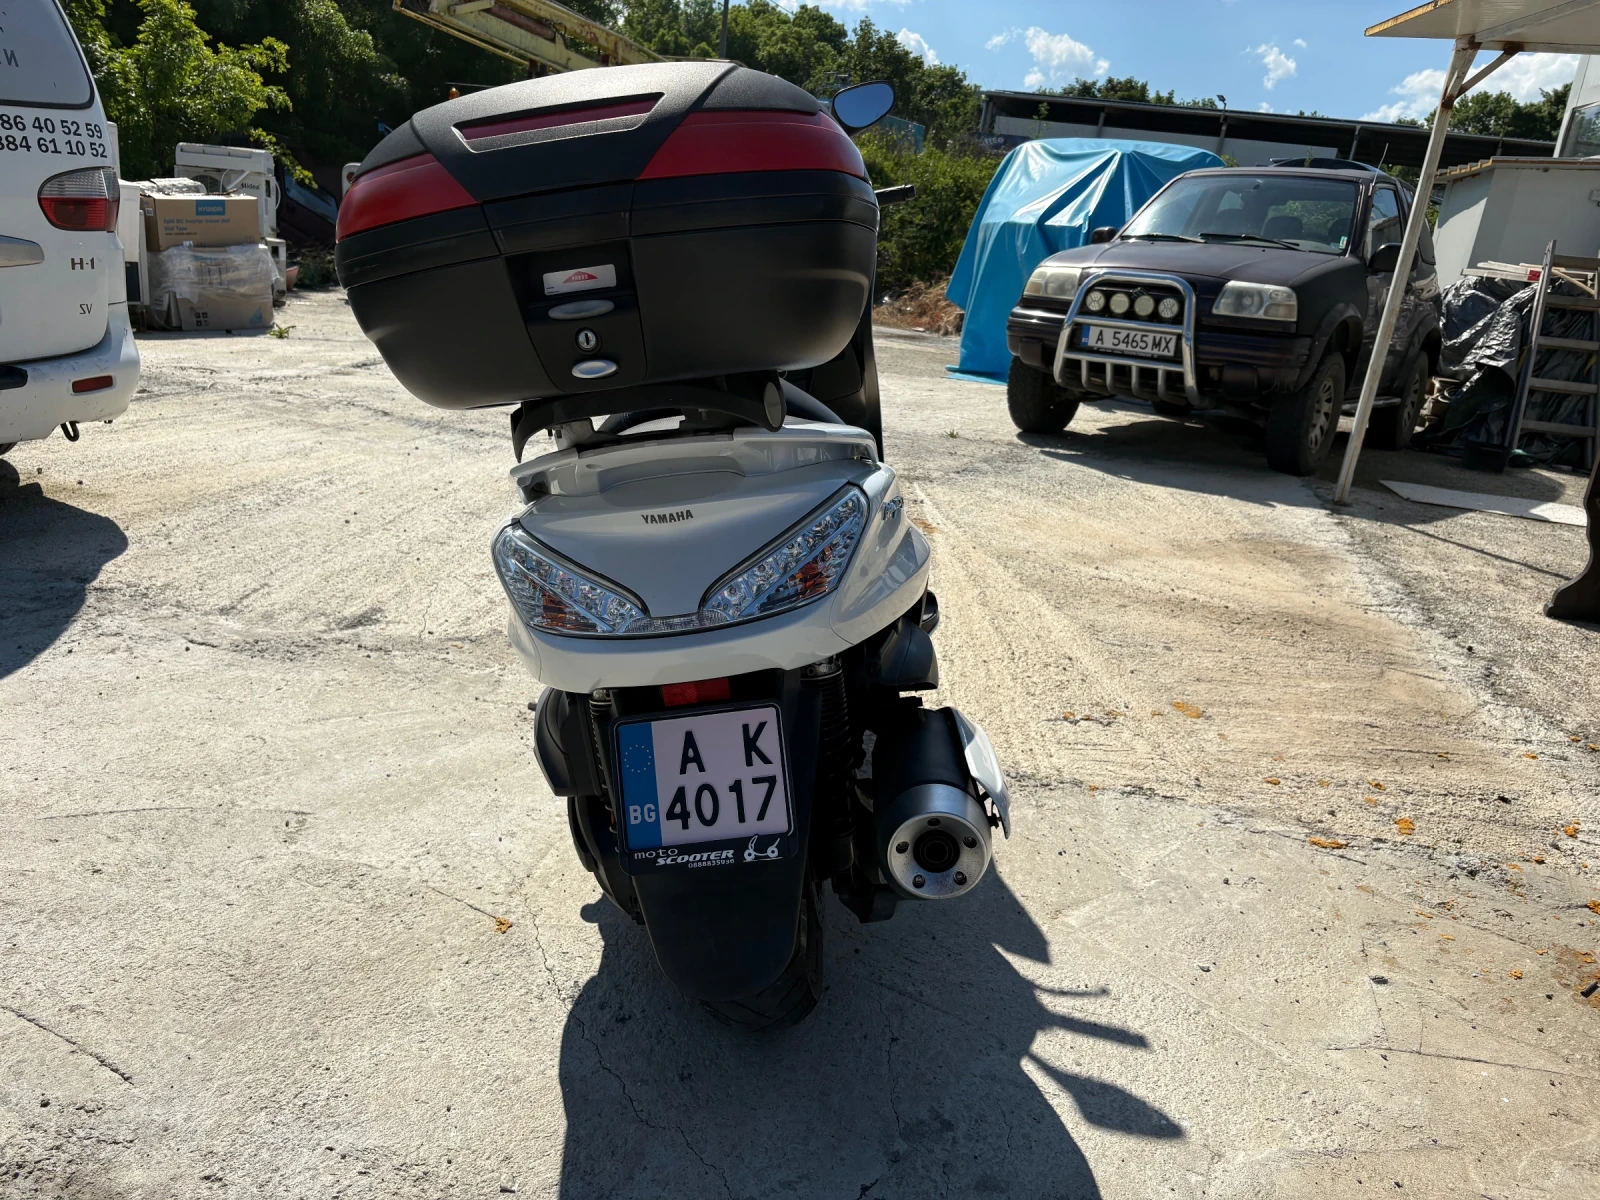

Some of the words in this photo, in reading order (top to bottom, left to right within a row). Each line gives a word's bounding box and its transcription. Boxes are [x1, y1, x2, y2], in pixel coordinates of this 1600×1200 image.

[32, 116, 56, 134] 40
[60, 119, 82, 137] 52
[85, 122, 103, 139] 59
[37, 137, 62, 154] 61
[65, 139, 86, 156] 10
[89, 142, 108, 159] 52
[71, 257, 95, 270] H-1
[1095, 330, 1104, 345] A
[1112, 331, 1149, 350] 5465
[1151, 335, 1173, 353] MX
[641, 509, 694, 525] YAMAHA
[680, 730, 706, 775] A
[742, 721, 773, 767] K
[666, 775, 777, 830] 4017
[629, 804, 656, 824] BG
[634, 848, 678, 859] moto
[656, 849, 734, 866] SCOOTER
